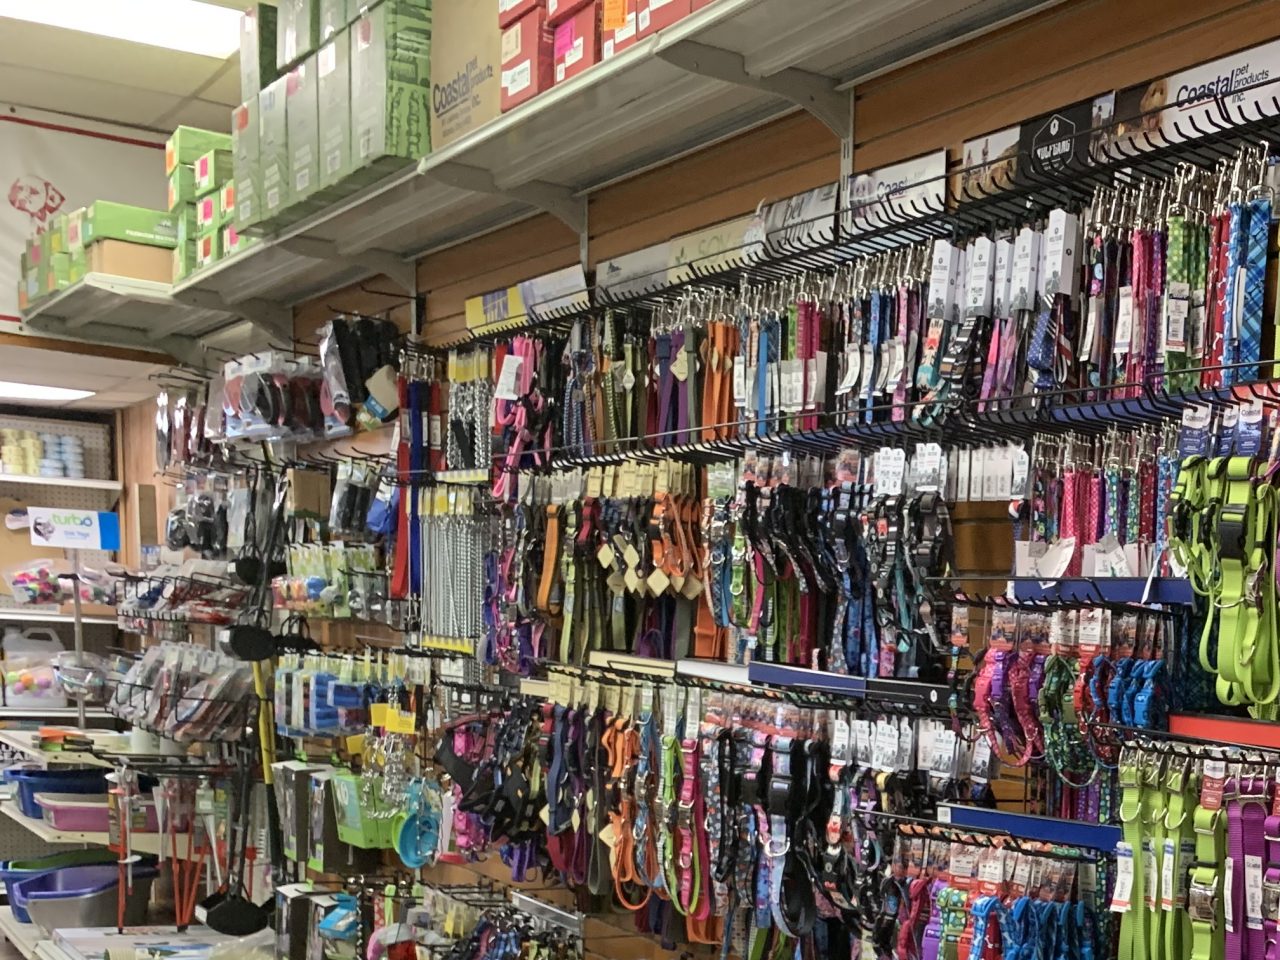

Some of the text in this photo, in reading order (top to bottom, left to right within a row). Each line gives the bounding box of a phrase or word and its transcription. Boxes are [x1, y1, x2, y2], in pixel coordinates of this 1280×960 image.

[433, 63, 471, 113] Coastal
[1177, 64, 1249, 107] Coastal pet
[1234, 69, 1269, 89] products
